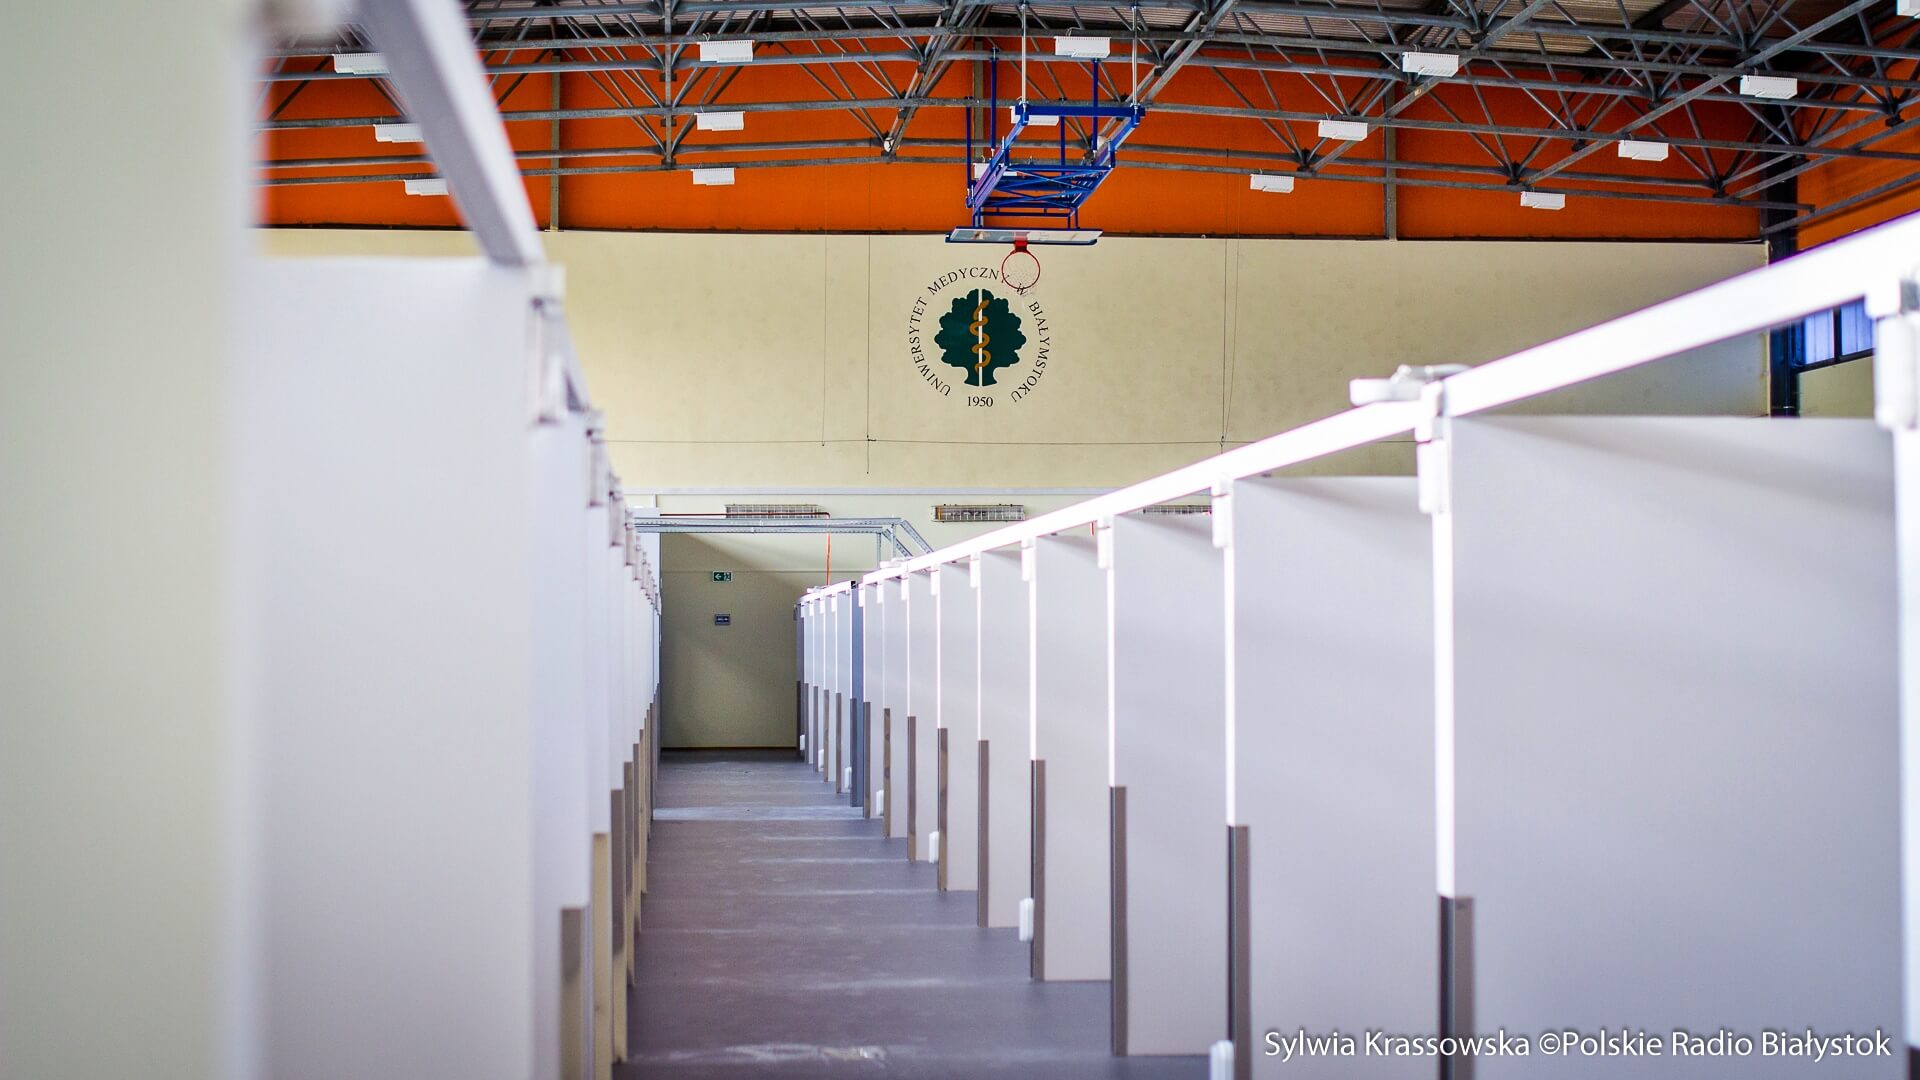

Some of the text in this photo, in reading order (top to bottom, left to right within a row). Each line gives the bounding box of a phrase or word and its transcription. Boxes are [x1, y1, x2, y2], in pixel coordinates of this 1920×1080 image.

[908, 297, 951, 396] UNIWERSYTET
[1010, 301, 1050, 402] BIAŁYMSTOKU
[967, 396, 994, 408] 1950
